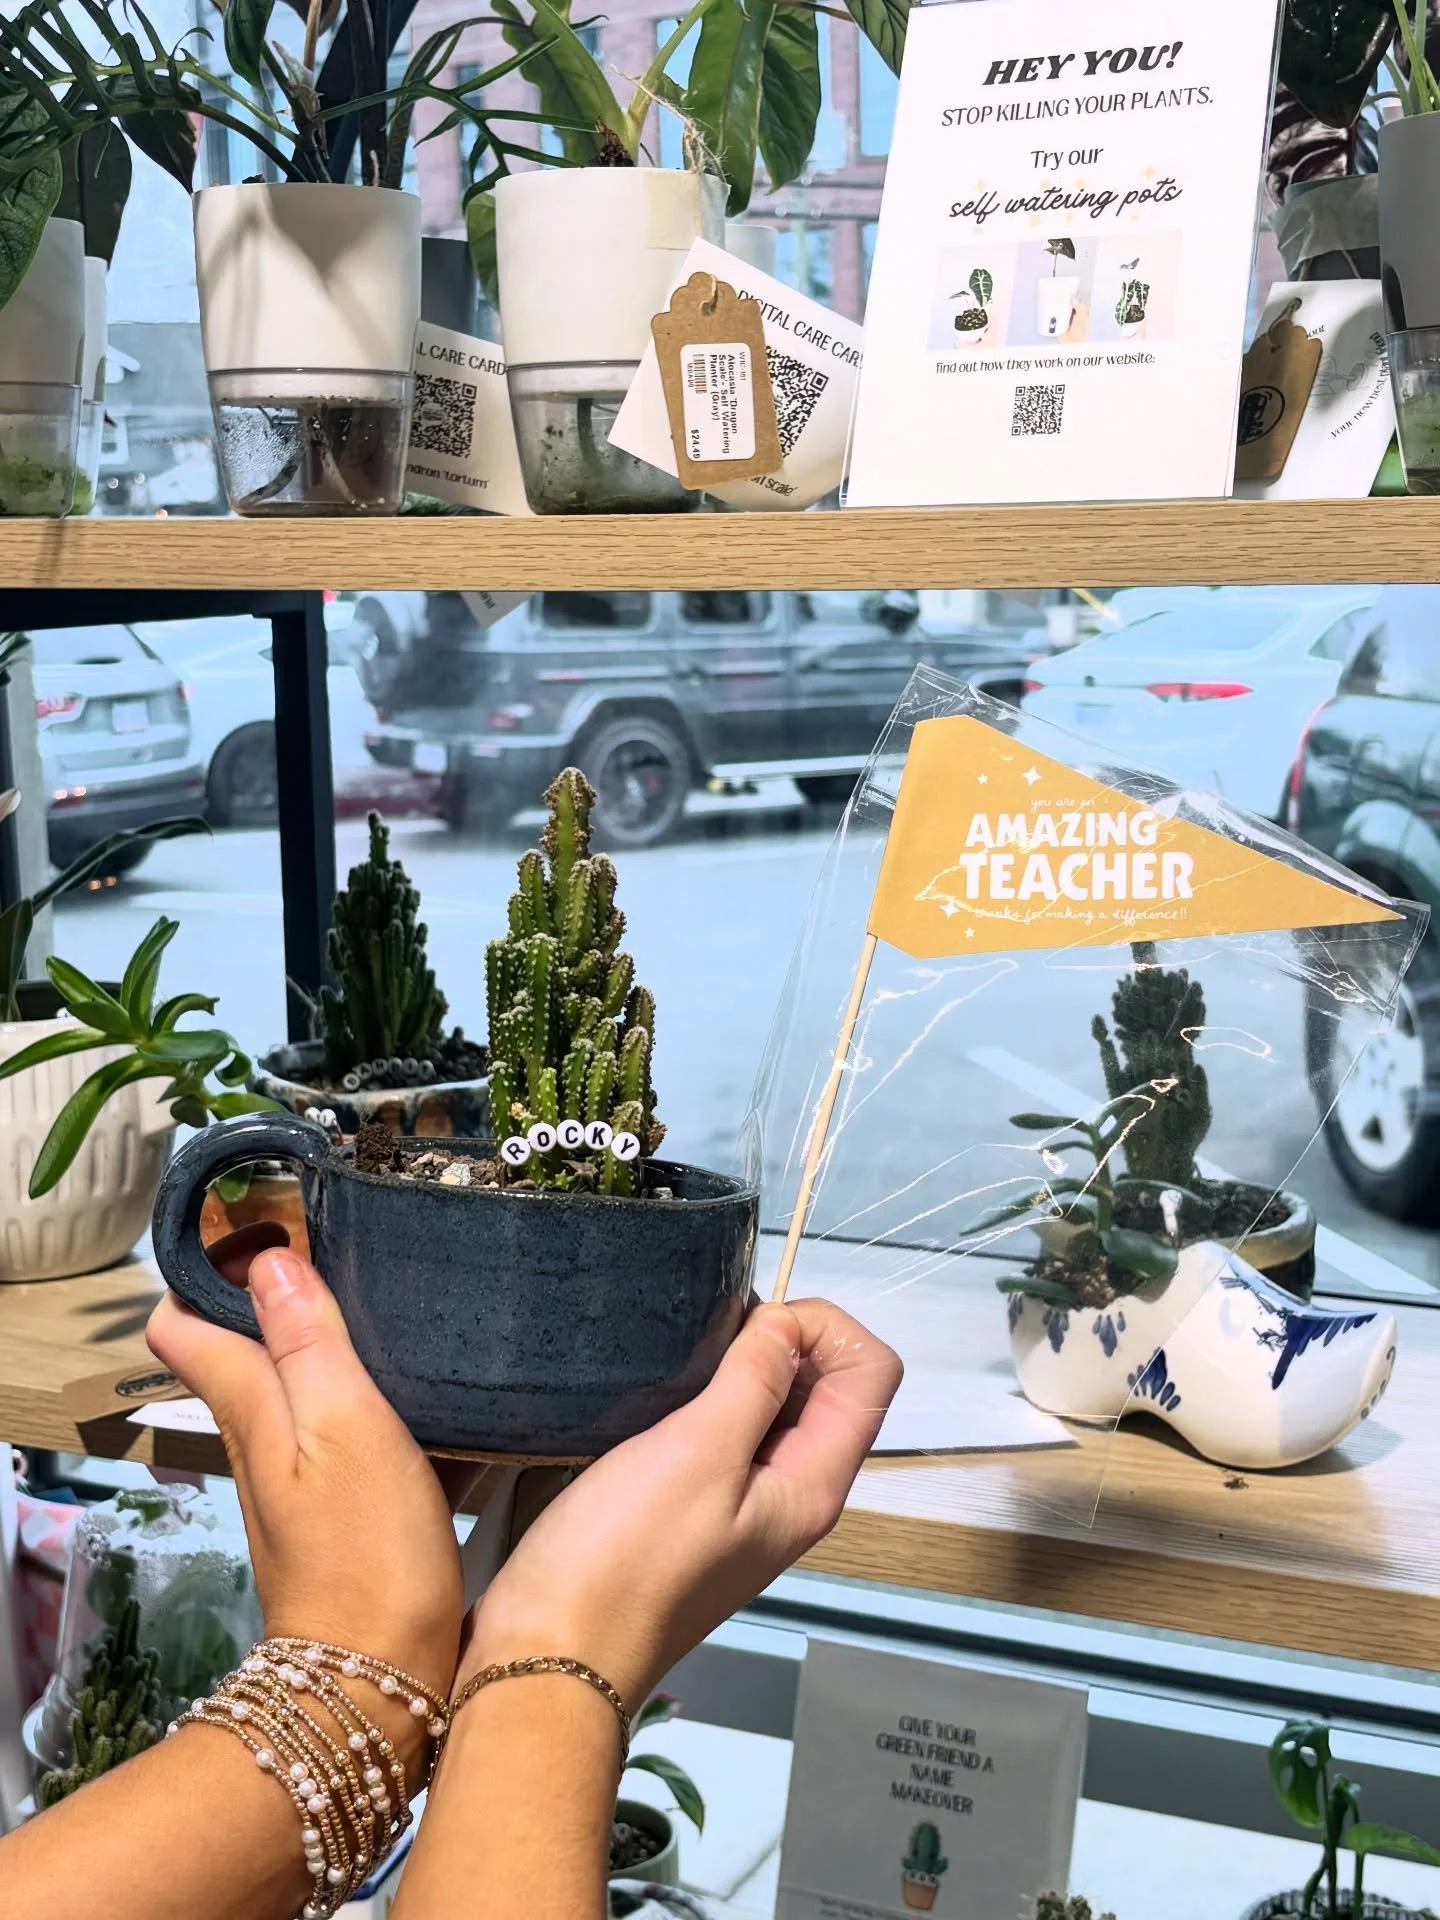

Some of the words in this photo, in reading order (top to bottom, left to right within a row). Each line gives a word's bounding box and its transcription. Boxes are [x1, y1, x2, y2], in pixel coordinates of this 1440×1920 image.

[982, 53, 1075, 85] HEY
[1083, 41, 1184, 77] YOU!
[941, 105, 993, 127] STOP
[996, 98, 1070, 122] KILLING
[1074, 93, 1126, 114] YOUR
[1130, 86, 1214, 110] PLANTS.
[1030, 150, 1064, 171] Try
[1068, 148, 1104, 165] our
[949, 190, 1000, 224] self
[1004, 186, 1119, 219] watering
[1115, 177, 1183, 217] pots
[737, 290, 790, 331] DITAL
[793, 320, 832, 351] CARE
[831, 341, 864, 369] CAR
[430, 344, 467, 366] CARE
[468, 355, 506, 376] CARD
[709, 354, 718, 393] Planter
[727, 353, 736, 395] Alocasia
[936, 362, 957, 374] find
[958, 361, 977, 373] out
[980, 359, 1005, 372] how
[1006, 358, 1032, 371] they
[1034, 356, 1064, 369] work
[1066, 356, 1081, 368] on
[1083, 355, 1104, 367] our
[1106, 352, 1156, 365] website:
[711, 391, 720, 421] (Gray)
[720, 389, 729, 409] Self
[691, 429, 701, 459] $24.49
[722, 411, 730, 454] Watering
[1030, 798, 1052, 813] you
[1055, 797, 1076, 807] are
[964, 811, 1158, 848] AMAZING
[959, 852, 1195, 901] TEACHER
[1046, 906, 1094, 926] making
[1099, 912, 1108, 920] a
[506, 1126, 635, 1161] ROCKY
[935, 1722, 977, 1746] YOUR
[876, 1733, 925, 1760] GREEN
[926, 1742, 981, 1770] FRIEND
[981, 1756, 995, 1774] A
[909, 1762, 954, 1788] NAME
[889, 1780, 974, 1814] MAKEOVER
